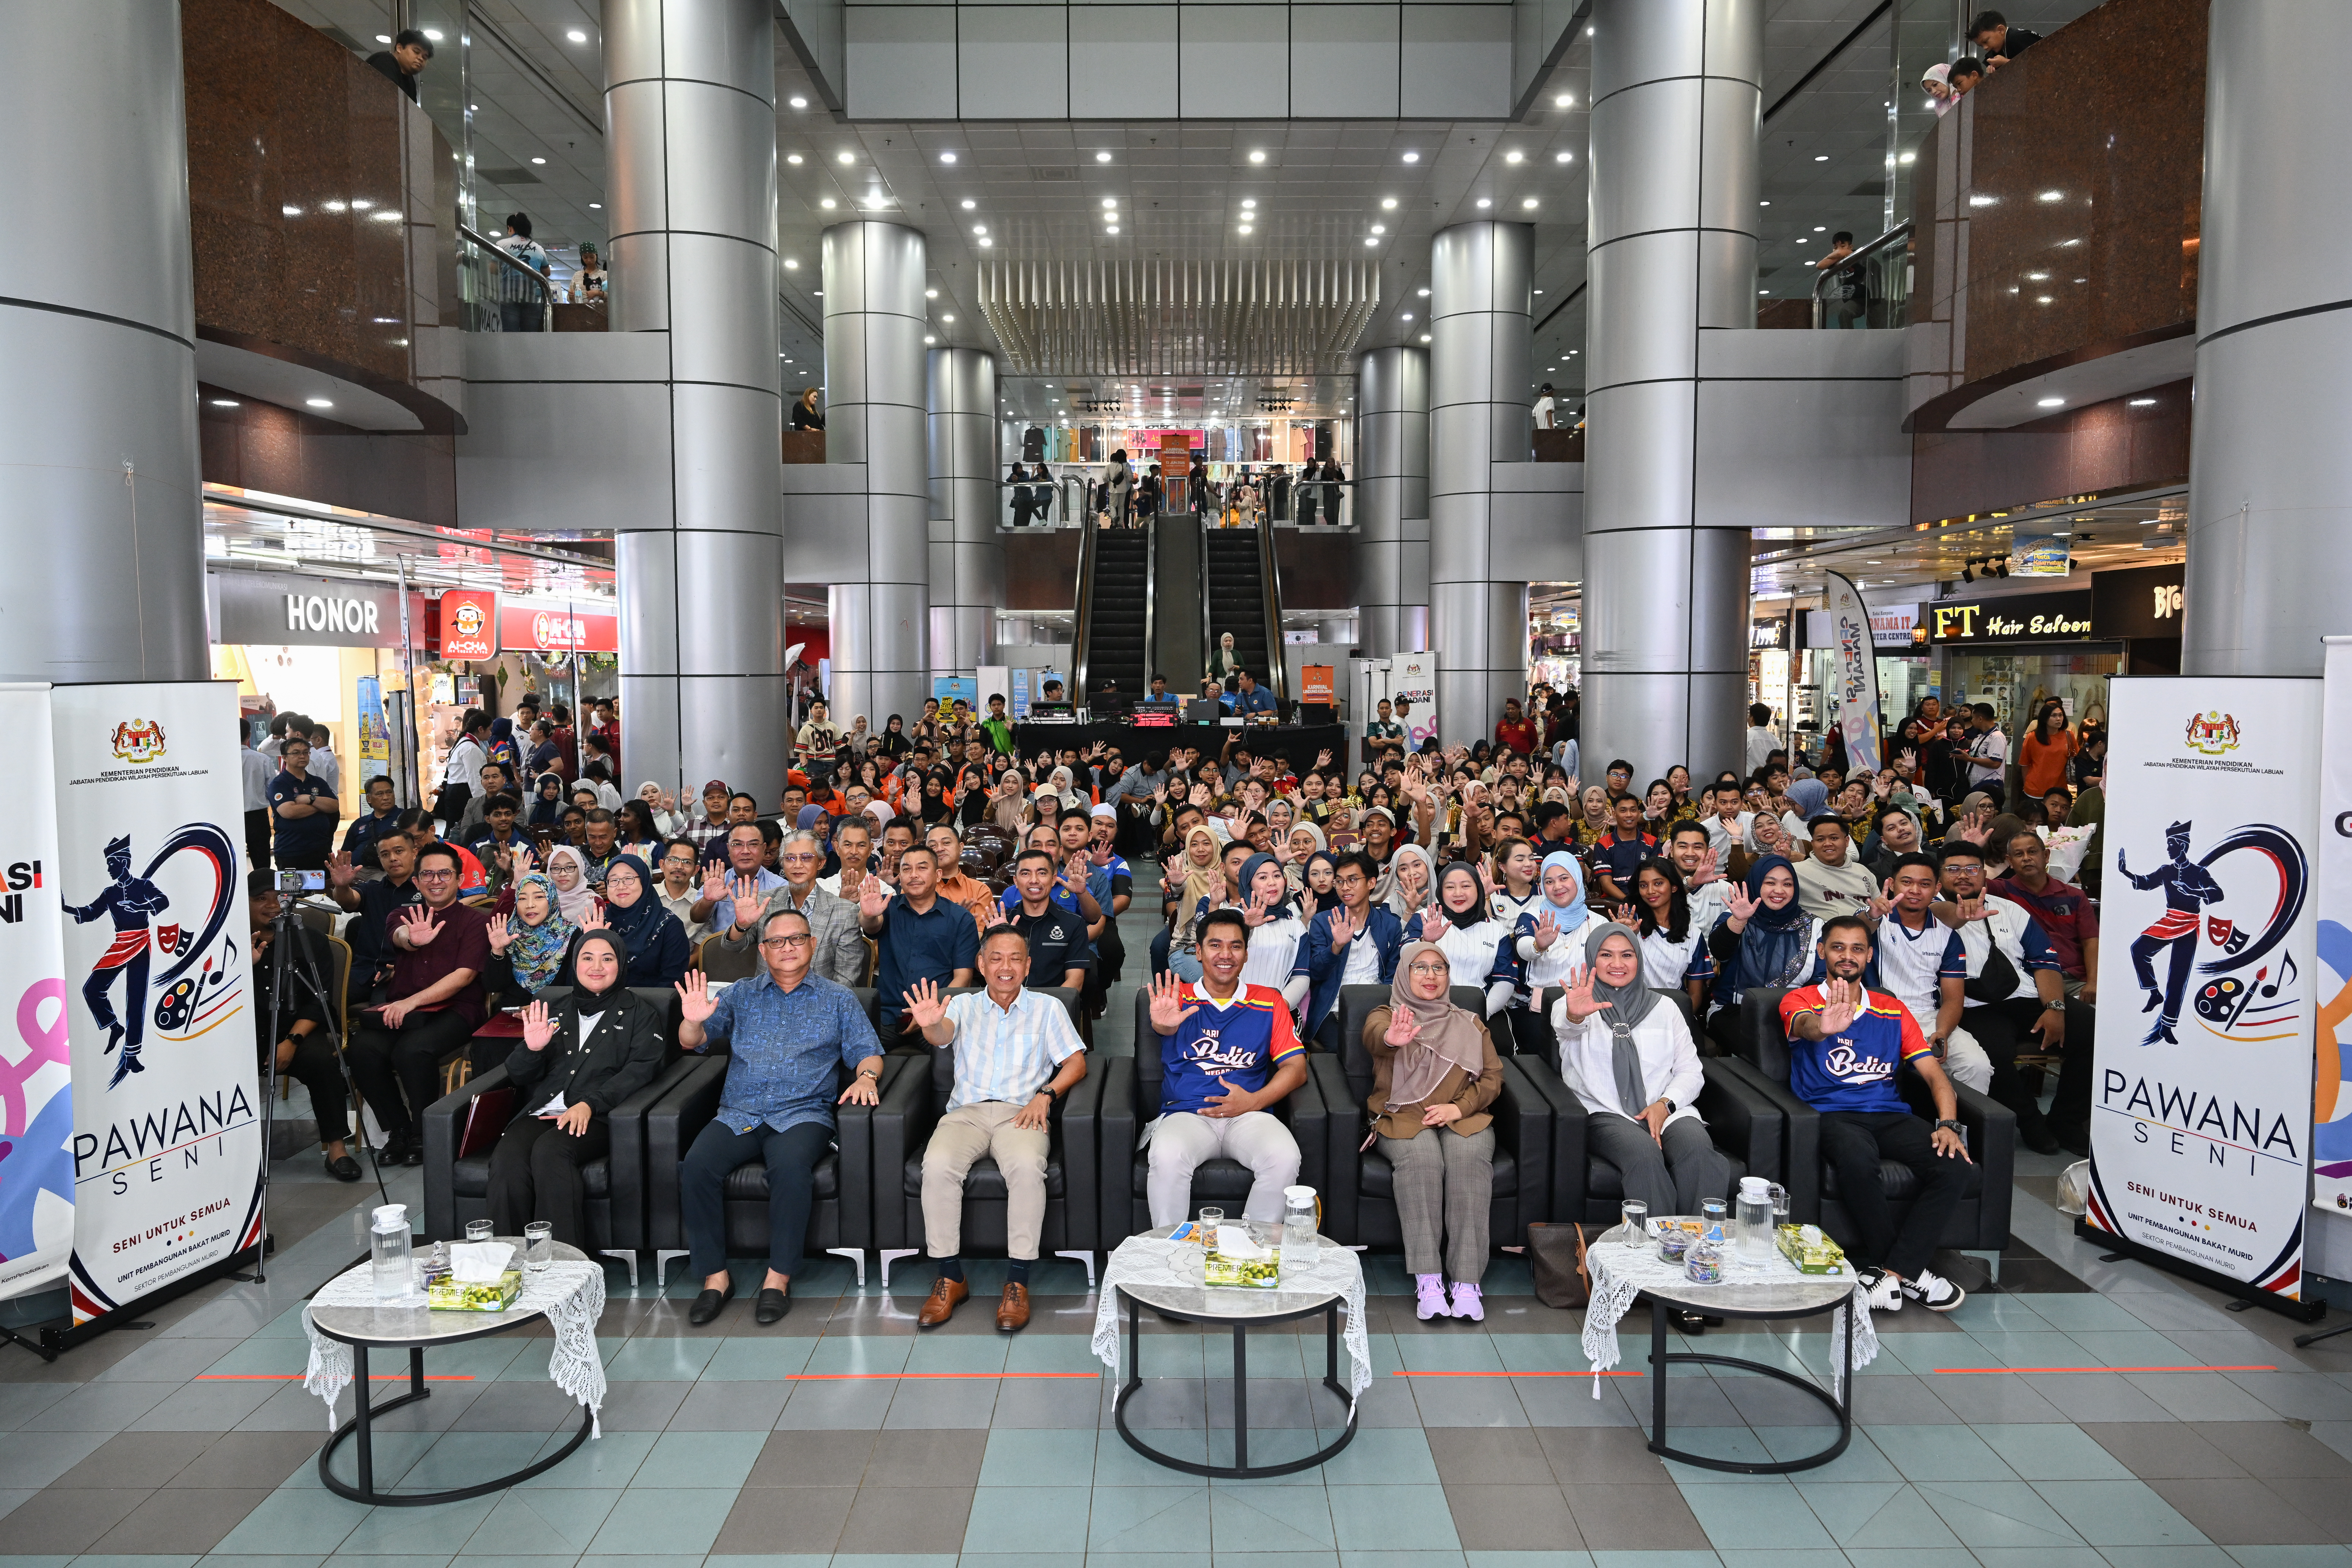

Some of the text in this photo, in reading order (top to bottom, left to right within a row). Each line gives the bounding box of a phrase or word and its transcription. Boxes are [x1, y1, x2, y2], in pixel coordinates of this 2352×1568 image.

[288, 594, 379, 634] HONOR
[2154, 585, 2184, 618] Bre
[1869, 616, 1910, 630] RNAMA IT
[1934, 605, 2090, 638] FT Hair Saloon
[448, 641, 488, 651] Ai-CHA
[435, 679, 447, 688] Coffee
[101, 769, 144, 777] KEMENTERIAN
[2335, 811, 2352, 838] G
[1184, 1037, 1256, 1062] Belia
[1825, 1046, 1893, 1076] Belia
[2104, 1068, 2297, 1158] PAWANA
[74, 1083, 253, 1178] PAWANA
[113, 1136, 223, 1195] SENI
[2134, 1122, 2255, 1176] SENI
[2127, 1181, 2257, 1233] SENI UNTUK SEMUA
[113, 1198, 231, 1254] SENI UNTUK SEMUA
[2128, 1212, 2253, 1261] UNIT PEMBANGUNAN BAKAT MURID
[118, 1229, 231, 1283] UNIT PEMBANGUNAN BAKAT MURID
[2142, 1232, 2235, 1270] SEKTOR PEMBANGUNAN MURID
[1, 1263, 49, 1284] KemPendidikan
[134, 1250, 218, 1292] SEKTOR PEMBANGUNAN MURID
[1208, 1264, 1242, 1272] PREMIER
[431, 1288, 465, 1297] PREMIER
